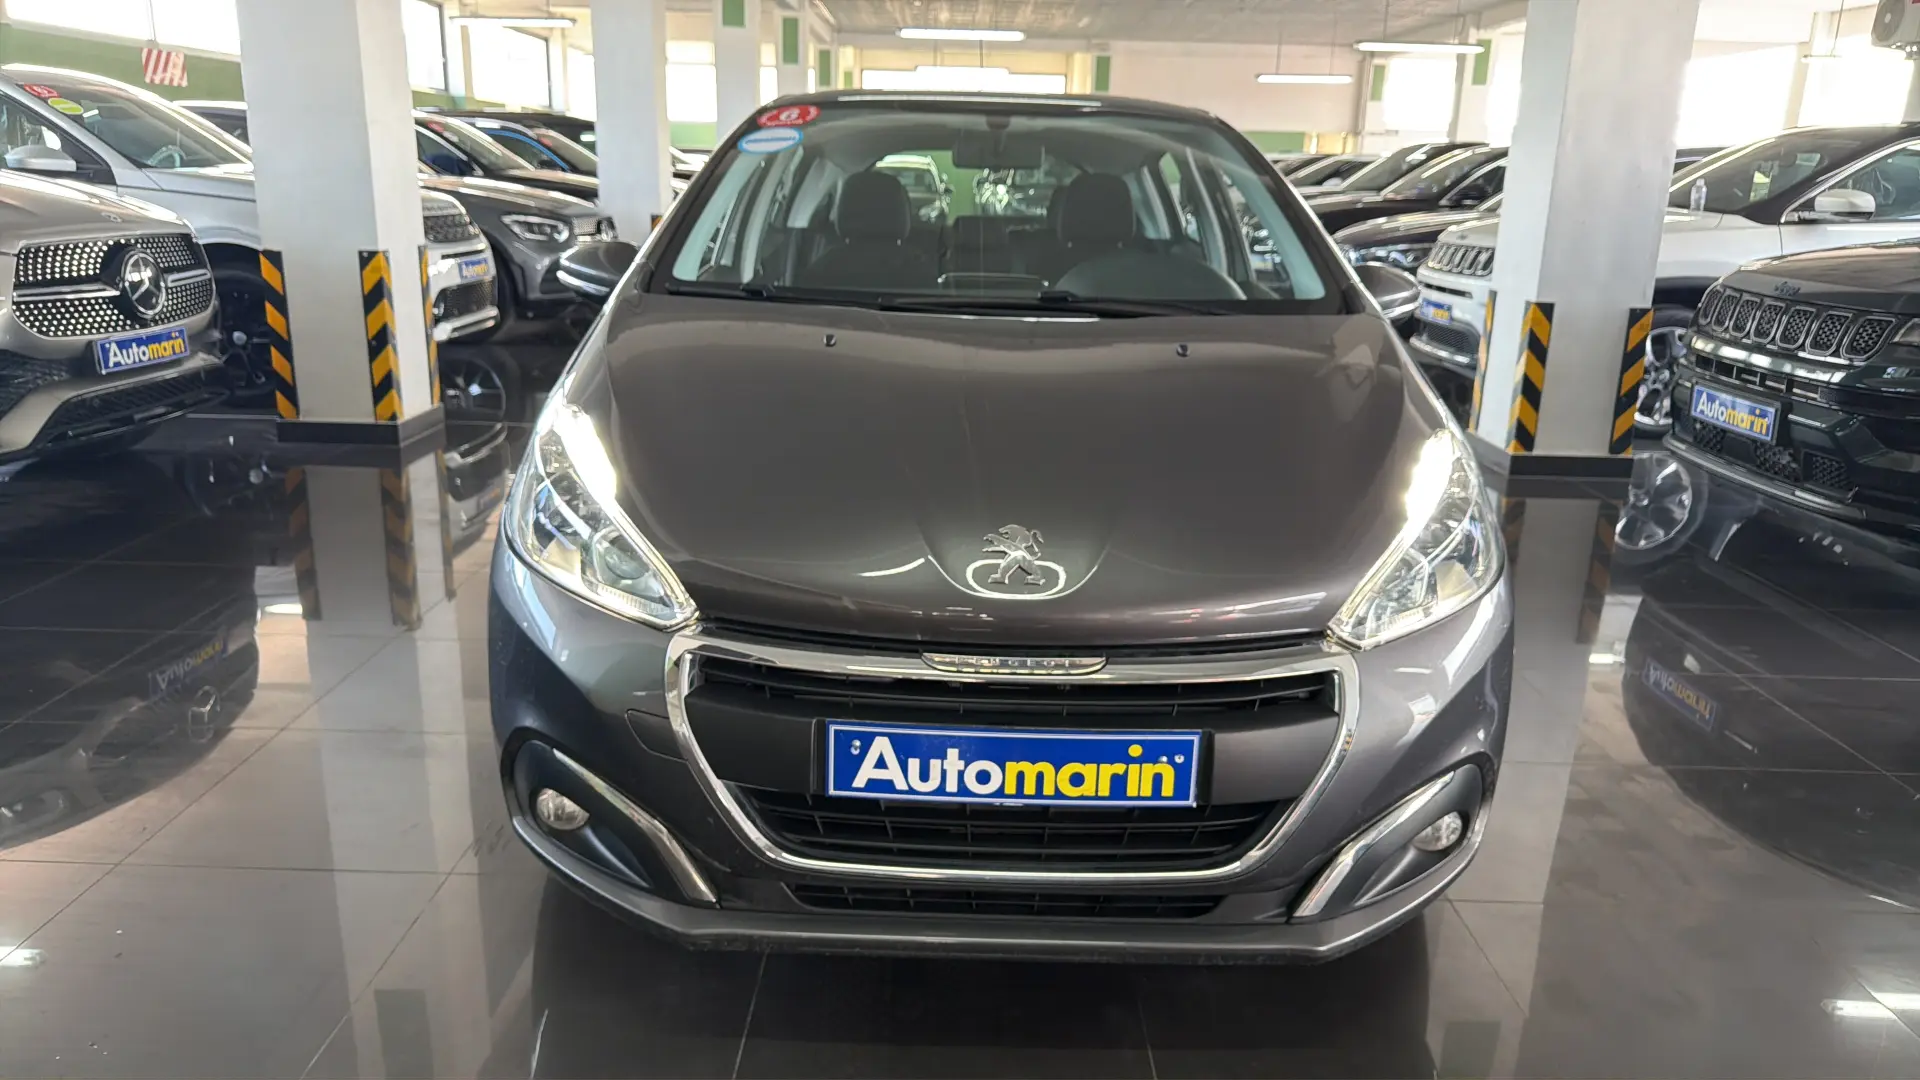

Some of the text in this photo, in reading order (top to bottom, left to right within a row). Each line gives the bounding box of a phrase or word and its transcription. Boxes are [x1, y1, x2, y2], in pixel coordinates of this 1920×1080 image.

[108, 331, 185, 368] Automarin
[1696, 391, 1768, 435] Automarin
[851, 736, 1175, 797] Automarin
